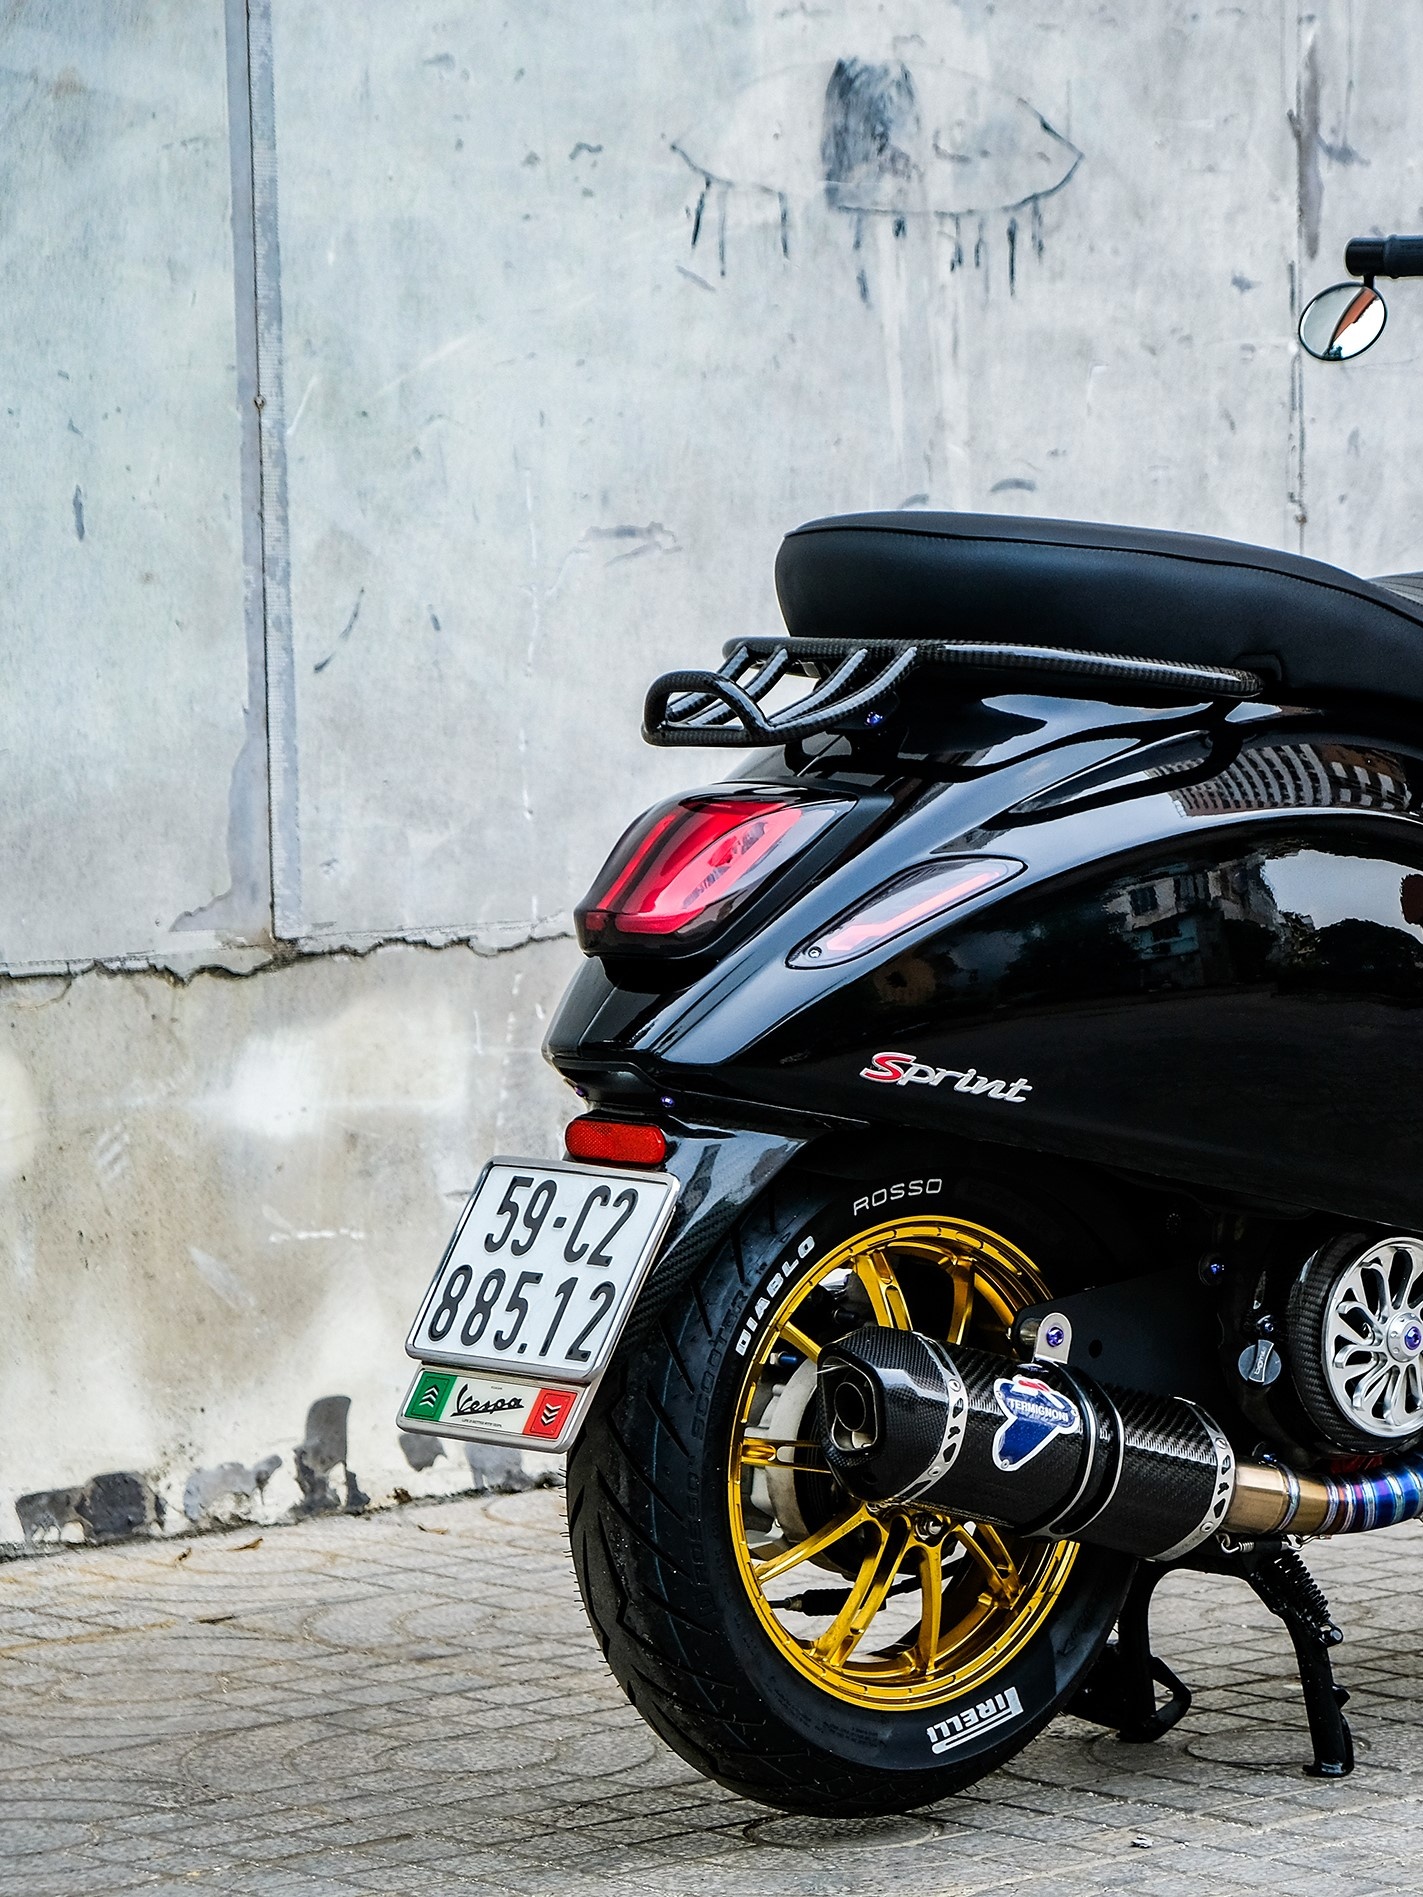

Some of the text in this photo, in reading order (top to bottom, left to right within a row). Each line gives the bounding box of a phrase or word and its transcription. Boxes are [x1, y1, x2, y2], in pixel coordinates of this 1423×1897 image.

[859, 1051, 1033, 1103] Sprint
[735, 1178, 943, 1356] DIABLO ROSSO
[427, 1264, 616, 1363] 885.12
[450, 1383, 525, 1418] Vespa
[1009, 1399, 1069, 1422] TERMIGNONI
[926, 1686, 1024, 1755] PIRELLI
